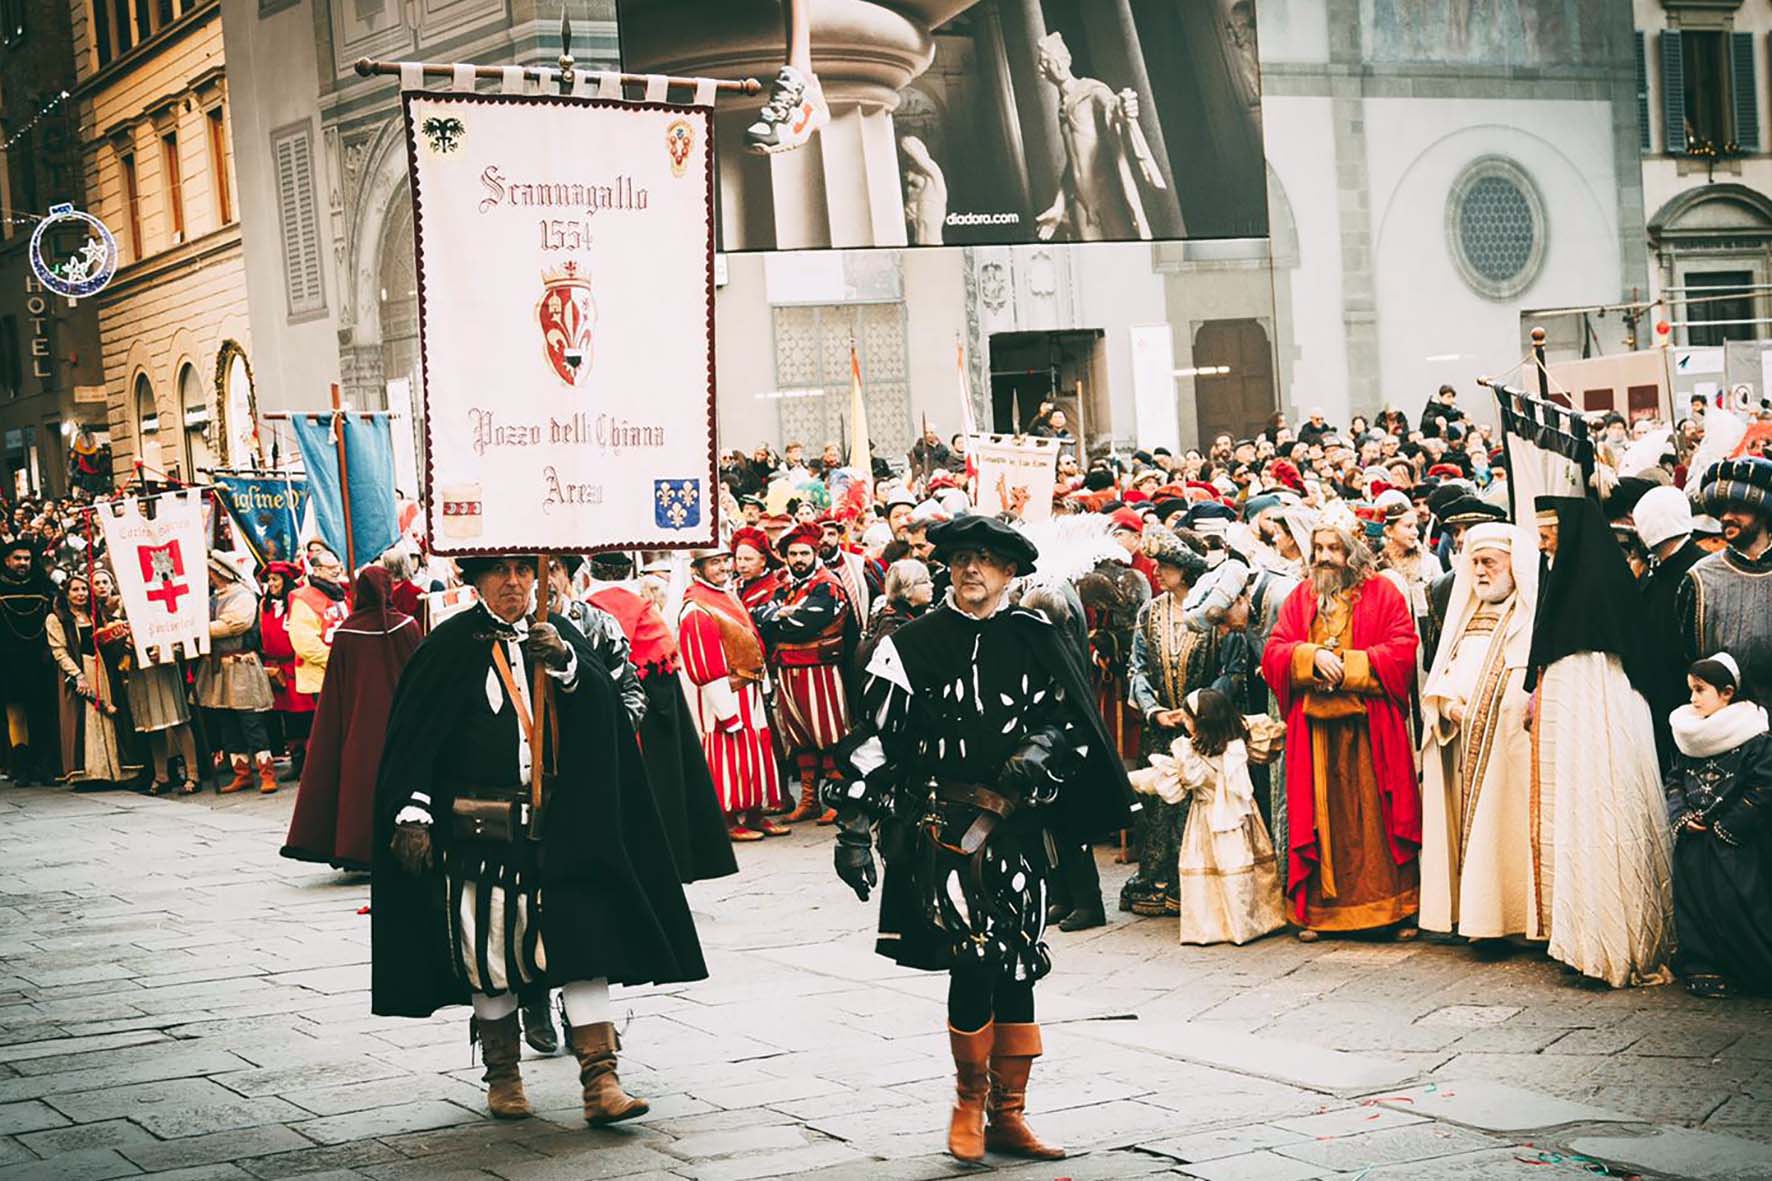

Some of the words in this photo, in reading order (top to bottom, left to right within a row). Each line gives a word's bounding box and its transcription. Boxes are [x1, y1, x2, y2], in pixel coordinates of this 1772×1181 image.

[478, 165, 649, 215] Scannagallo
[539, 219, 593, 252] 1554
[946, 212, 1019, 225] diadora.com
[26, 275, 51, 377] HOTEL
[468, 407, 541, 456] Pozzo
